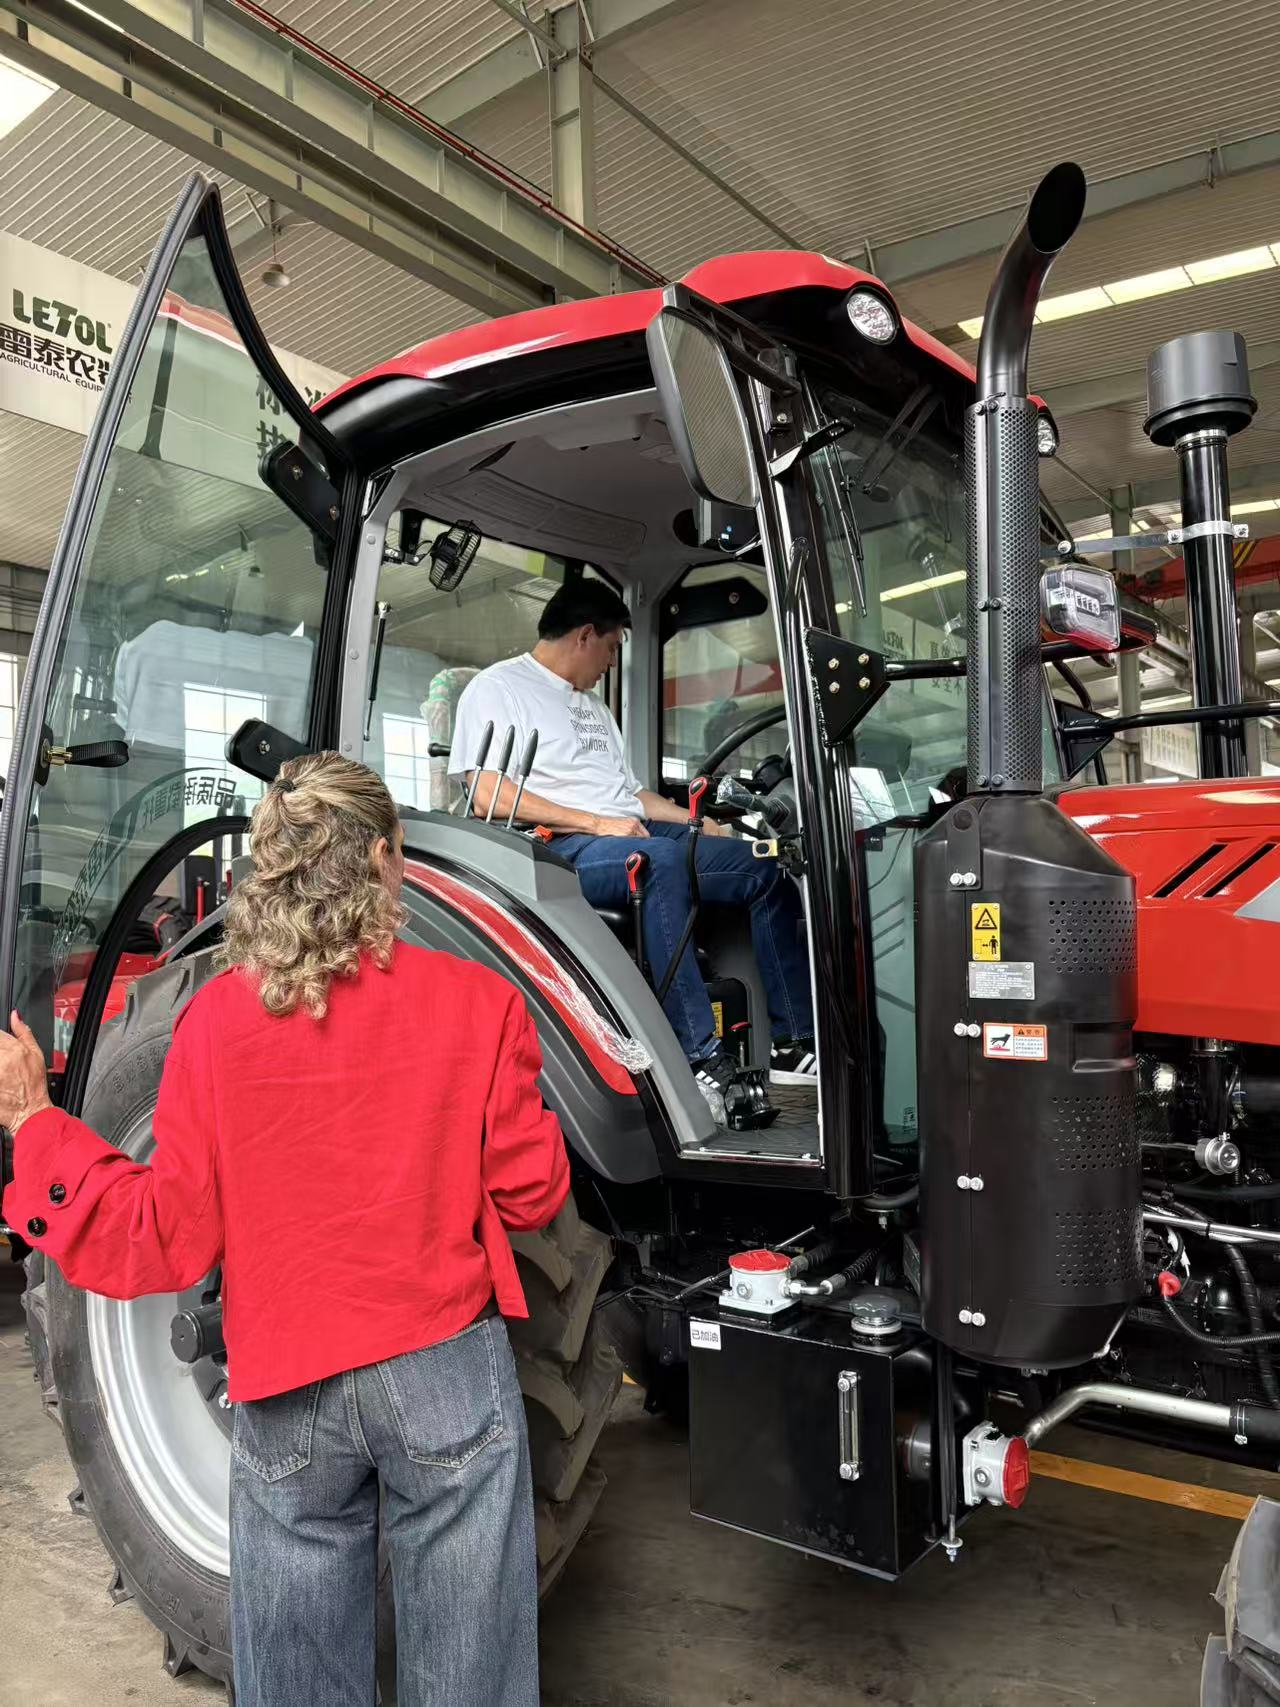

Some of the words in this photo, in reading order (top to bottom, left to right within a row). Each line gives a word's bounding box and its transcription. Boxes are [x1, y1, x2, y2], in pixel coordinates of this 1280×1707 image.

[12, 288, 113, 355] LETOL
[0, 353, 72, 383] AGRICULTURAL
[75, 377, 105, 393] EQUIP
[588, 737, 609, 752] WORK
